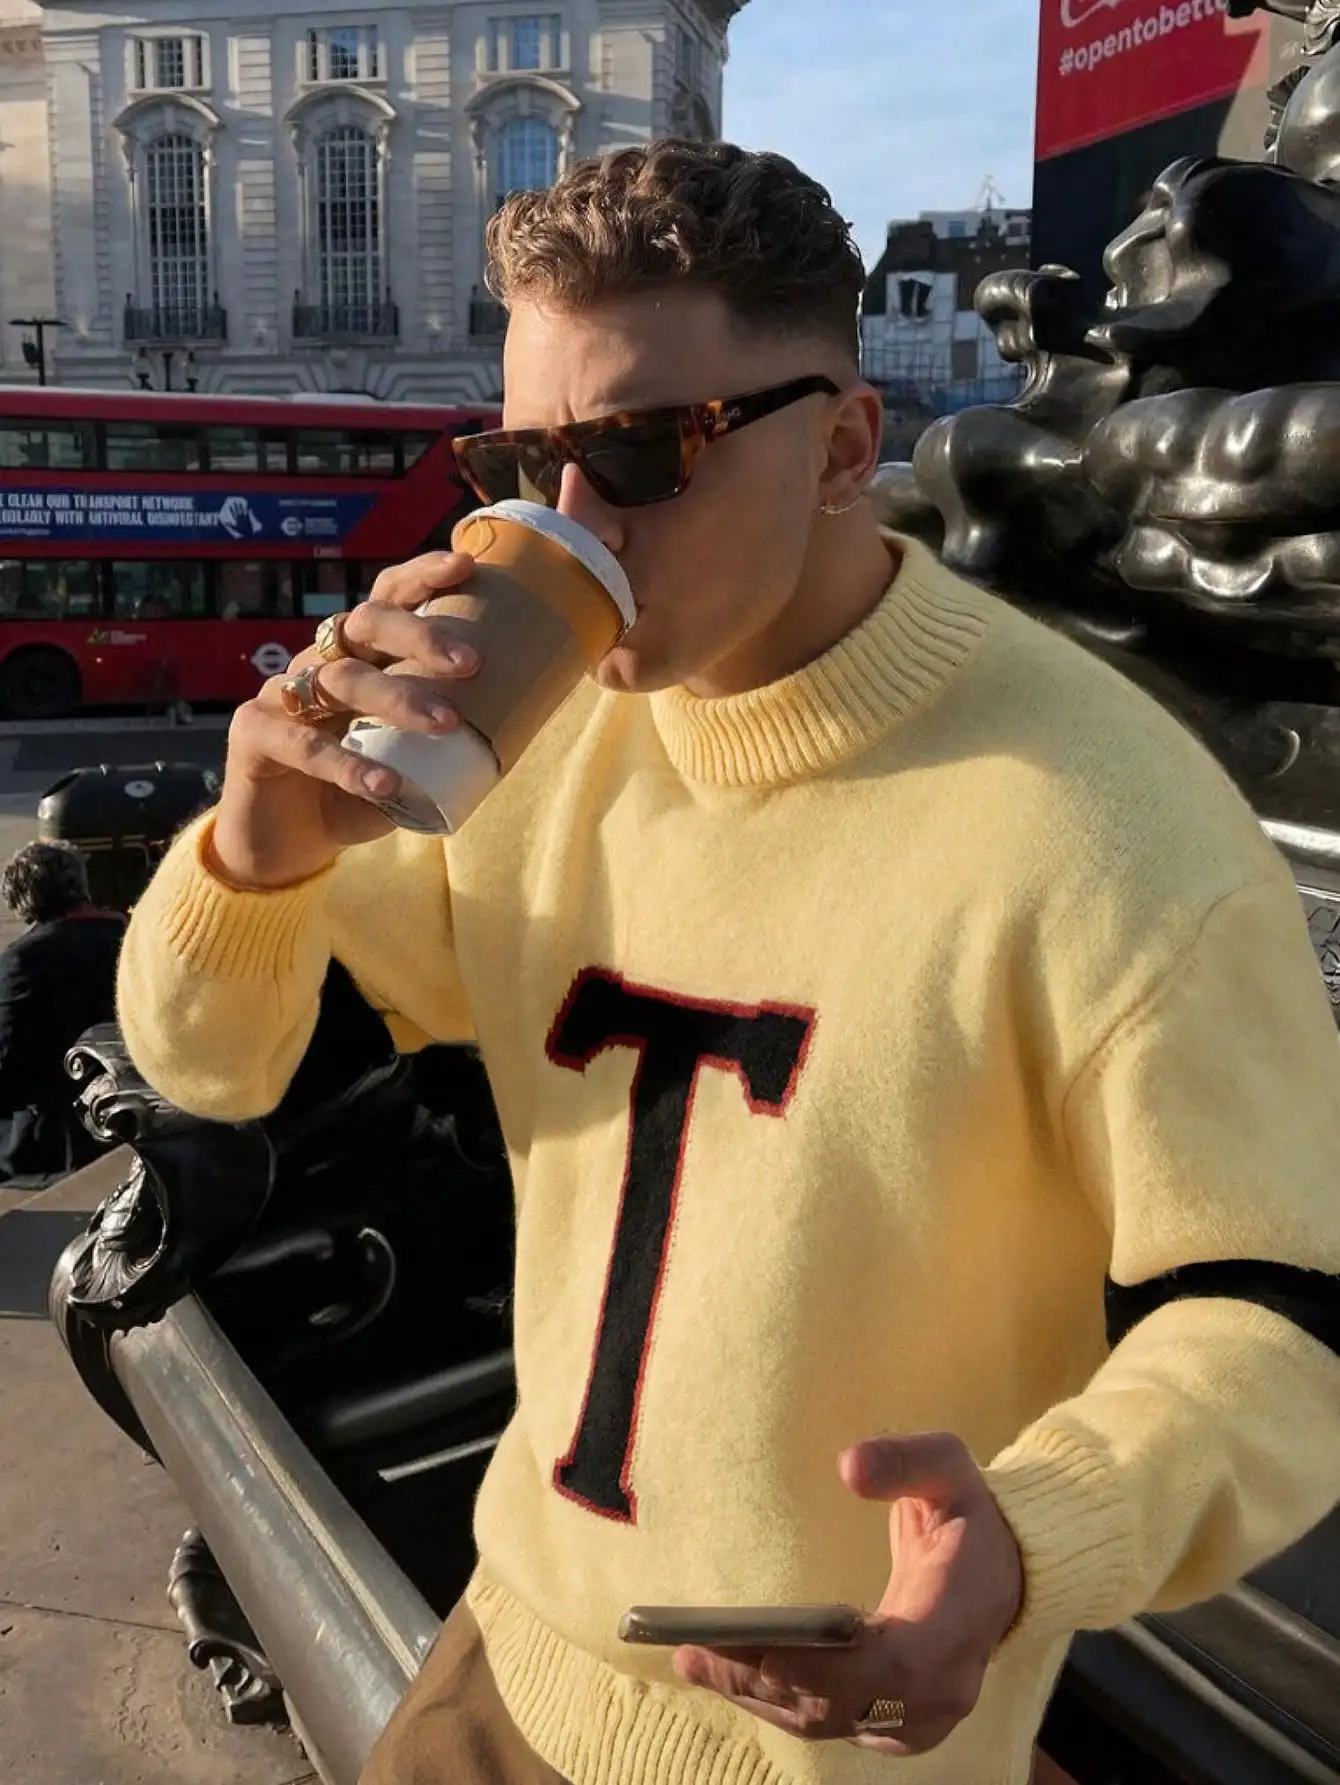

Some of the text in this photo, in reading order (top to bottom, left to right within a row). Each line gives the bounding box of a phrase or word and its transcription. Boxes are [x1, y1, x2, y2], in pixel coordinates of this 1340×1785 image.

[8, 493, 43, 508] CLEAN
[55, 510, 84, 526] WITH
[545, 965, 818, 1526] T
